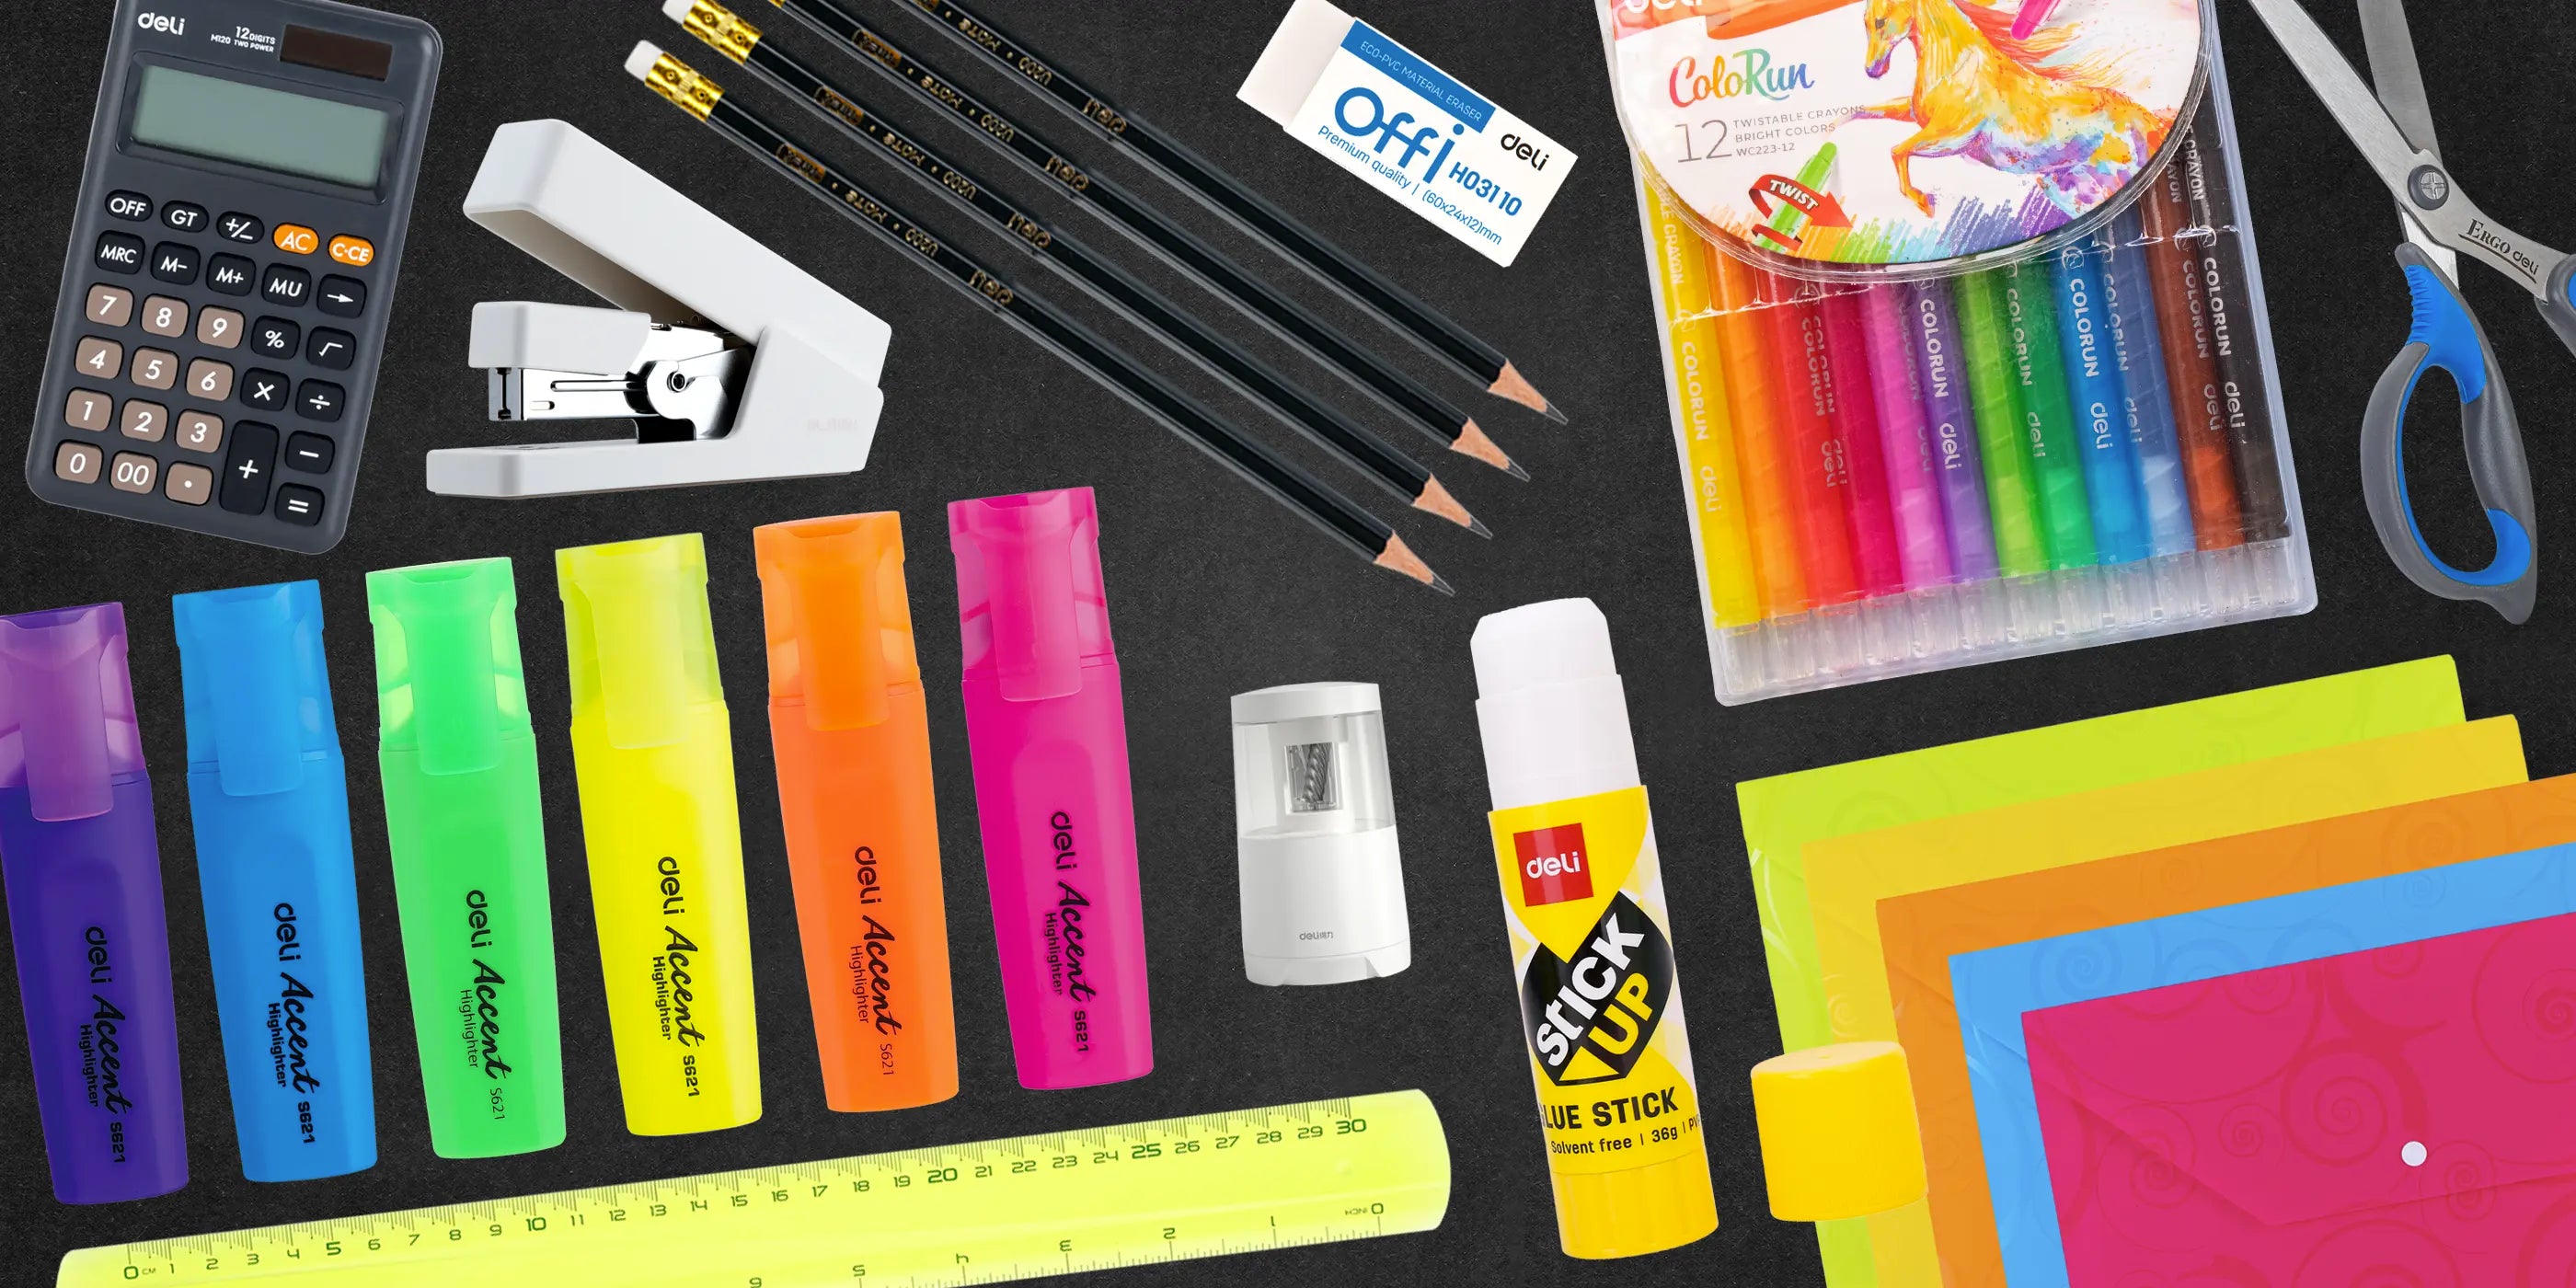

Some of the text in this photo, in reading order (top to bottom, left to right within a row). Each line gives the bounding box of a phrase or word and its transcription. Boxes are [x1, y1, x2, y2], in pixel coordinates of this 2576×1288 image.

[138, 12, 186, 36] deli
[234, 39, 249, 48] TWO
[249, 43, 275, 52] POWER
[1018, 56, 1052, 86] U200
[1360, 40, 1483, 122] ECO-PVC MATERIAL ERASER
[1669, 48, 1815, 108] ColoRun
[980, 113, 1015, 144] U200
[1674, 120, 1732, 163] 12
[1733, 105, 1866, 129] TWISTABLE CRAYONS
[1735, 123, 1836, 144] BRIGHT COLORS
[1317, 125, 1371, 164] Premium
[1372, 159, 1412, 190] quality
[1501, 133, 1550, 172] deli
[1736, 143, 1796, 157] WC223-12
[2185, 138, 2205, 201] CRAYON
[942, 170, 977, 201] U200
[1769, 178, 1819, 211] TWIST
[109, 197, 147, 217] OFF
[170, 209, 197, 227] GT
[281, 230, 312, 252] AC
[904, 228, 938, 258] U200
[101, 244, 137, 264] MRC
[215, 267, 244, 284] M+
[270, 279, 302, 297] MU
[2513, 249, 2540, 276] deli
[98, 294, 284, 349] 7 8 9 %
[2182, 259, 2223, 432] COLORUN deli
[2203, 257, 2247, 430] COLORUN deli
[89, 349, 216, 391] 4 5 6
[1920, 298, 1962, 470] COLORUN deli
[2007, 288, 2047, 458] COLORUN deli
[2069, 278, 2114, 450] COLORUN deli
[83, 400, 208, 443] 1 2 3
[1682, 341, 1723, 514] COLORUN deli
[69, 453, 149, 486] 0 00
[1525, 850, 1582, 880] deli
[854, 845, 903, 1076] deli Accent S621
[1045, 912, 1064, 996] Highlighter
[1050, 810, 1098, 1052] deli Accent S621
[466, 889, 512, 1121] deli Accent S621
[651, 955, 673, 1041] Highlighter
[657, 856, 706, 1098] deli Accent S621
[849, 945, 869, 1024] Highlighter
[273, 902, 320, 1144] deli Accent S621
[459, 988, 481, 1069] Highlighter
[1587, 972, 1653, 1055] UP
[79, 1023, 101, 1108] Highlighter
[85, 926, 133, 1164] deli Accent S621
[267, 1002, 289, 1088] Highlighter
[1592, 1087, 1679, 1127] STICK
[1551, 1140, 1595, 1155] Solvent
[1601, 1137, 1633, 1153] free
[1650, 1126, 1679, 1144] 36g
[124, 1266, 138, 1279] 0
[169, 1263, 174, 1274] 1
[206, 1258, 219, 1271] 2
[247, 1253, 259, 1265] 3
[287, 1248, 300, 1259] 4
[326, 1241, 341, 1256] 5
[368, 1238, 380, 1251] 6
[408, 1234, 420, 1247] 7
[449, 1229, 462, 1241] 8
[489, 1225, 502, 1236] 9
[526, 1217, 546, 1232] 10
[570, 1213, 584, 1226] 11
[609, 1209, 627, 1222] 12
[650, 1204, 667, 1217] 13
[690, 1200, 707, 1212] 14
[730, 1195, 748, 1207] 15
[771, 1190, 788, 1202] 16
[812, 1185, 828, 1198] 17
[853, 1180, 870, 1192] 18
[893, 1176, 911, 1188] 19
[927, 1167, 958, 1184] 20
[974, 1166, 993, 1179] 21
[1011, 1160, 1037, 1174] 22
[1052, 1156, 1078, 1169] 23
[1093, 1151, 1119, 1165] 24
[1131, 1144, 1162, 1159] 25
[1174, 1141, 1201, 1155] 26
[1215, 1135, 1240, 1149] 27
[1257, 1131, 1282, 1144] 28
[1297, 1126, 1323, 1140] 29
[1335, 1119, 1367, 1135] 30
